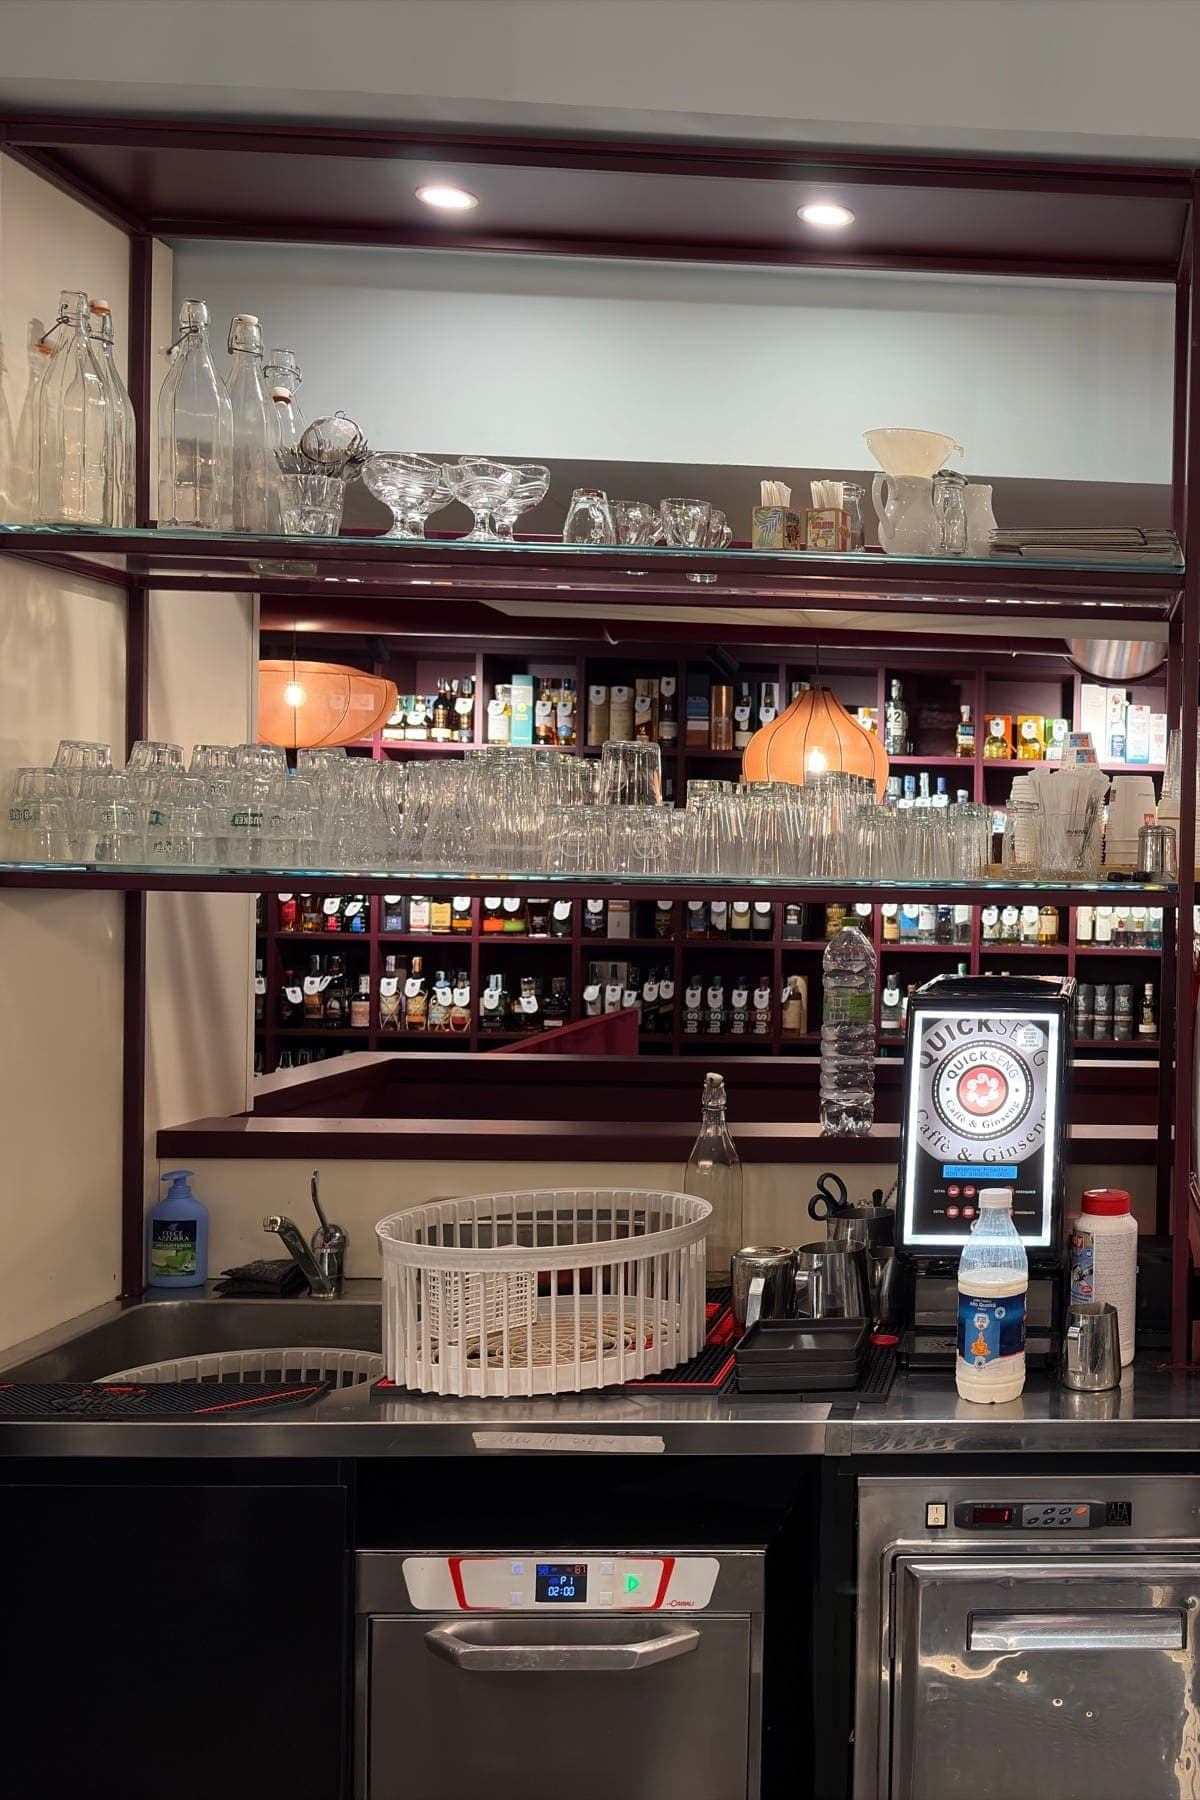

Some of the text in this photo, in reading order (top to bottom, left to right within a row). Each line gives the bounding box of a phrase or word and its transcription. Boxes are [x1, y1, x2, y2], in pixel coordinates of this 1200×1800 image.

[946, 1050, 1019, 1080] QUICKSENG
[968, 1119, 978, 1129] &
[982, 1101, 1020, 1129] Ginseng
[957, 1146, 972, 1162] &
[548, 1586, 575, 1597] 02:00
